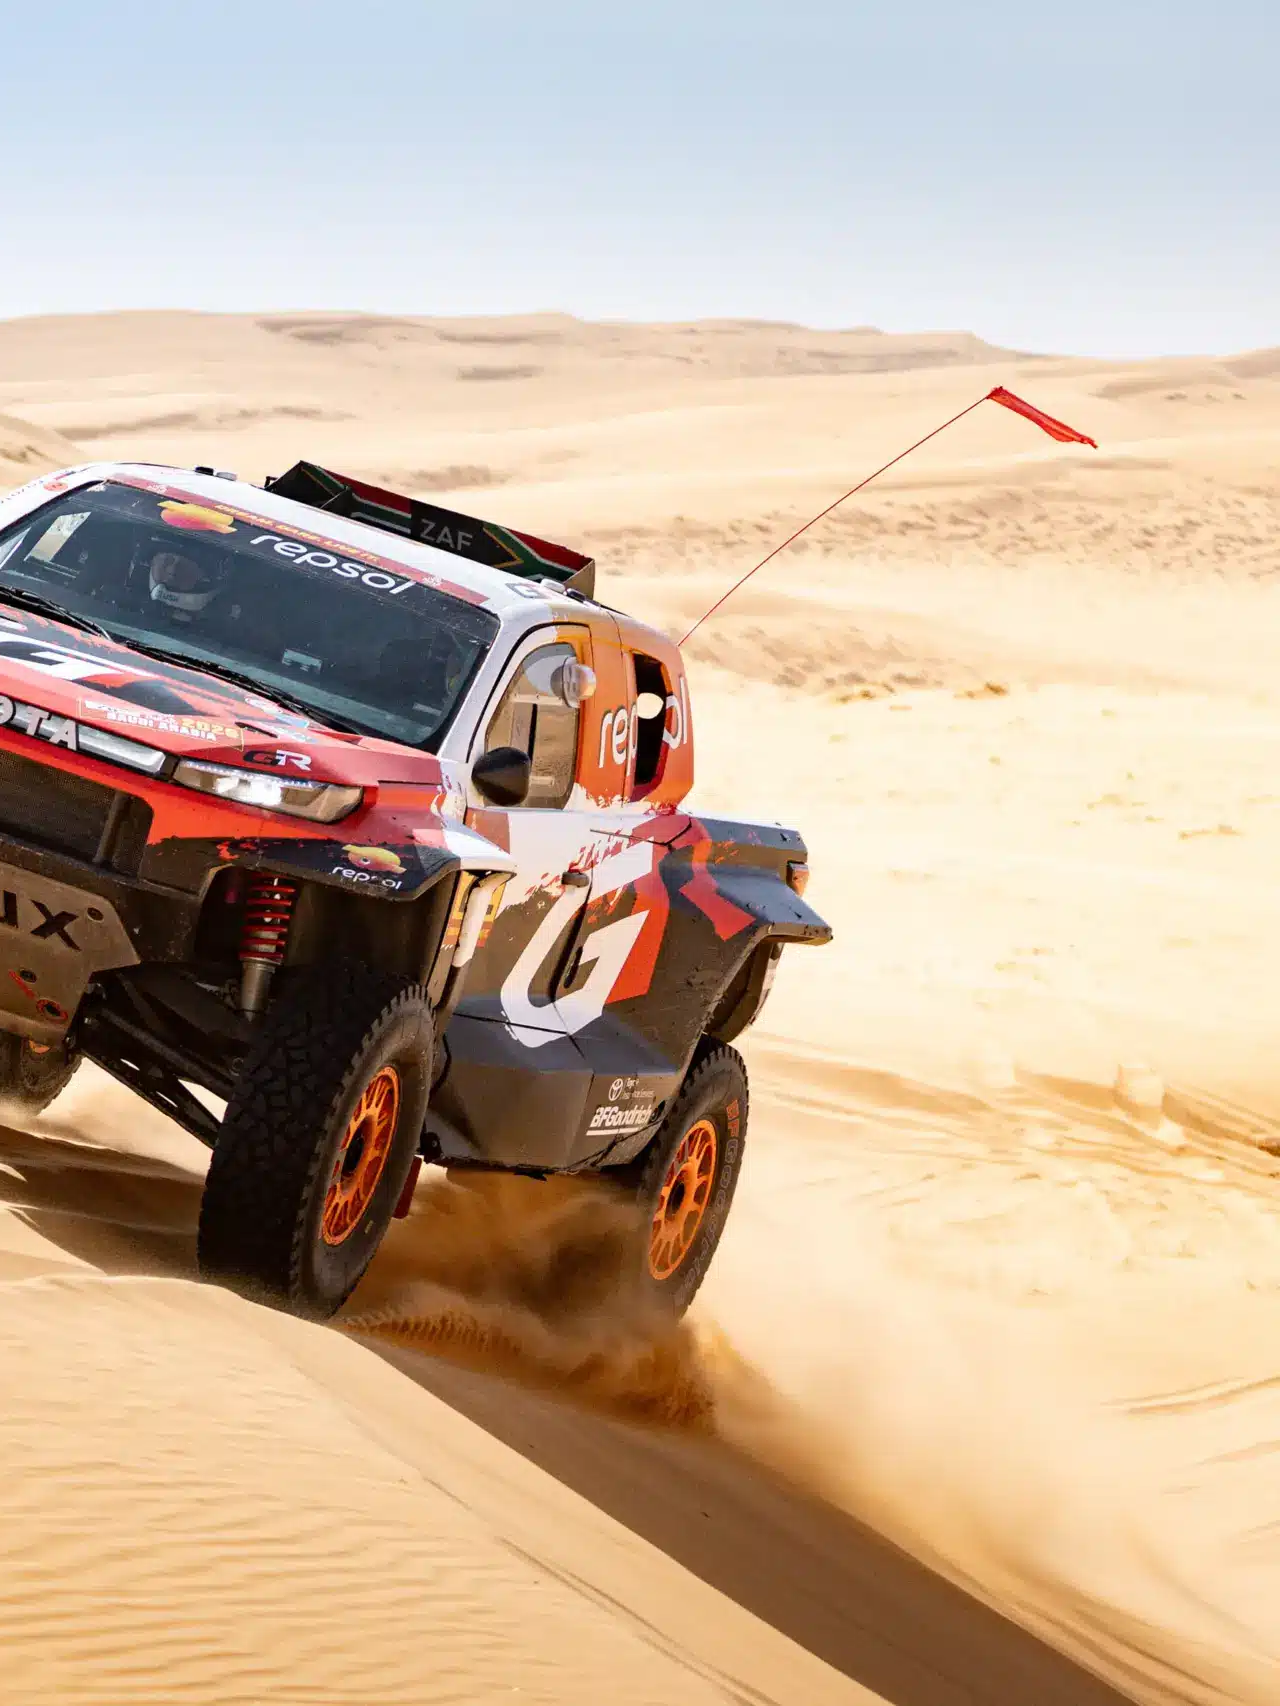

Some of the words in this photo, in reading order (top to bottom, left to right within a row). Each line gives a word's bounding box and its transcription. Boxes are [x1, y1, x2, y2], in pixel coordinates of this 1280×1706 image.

[420, 518, 473, 551] ZAF
[250, 534, 417, 595] repsol
[106, 711, 154, 729] SAUDI
[157, 721, 217, 742] ARABIA
[181, 717, 241, 740] 2026
[598, 676, 688, 777] repol
[242, 749, 313, 772] GR
[331, 866, 403, 890] repol
[589, 1104, 653, 1128] BFGoodrich
